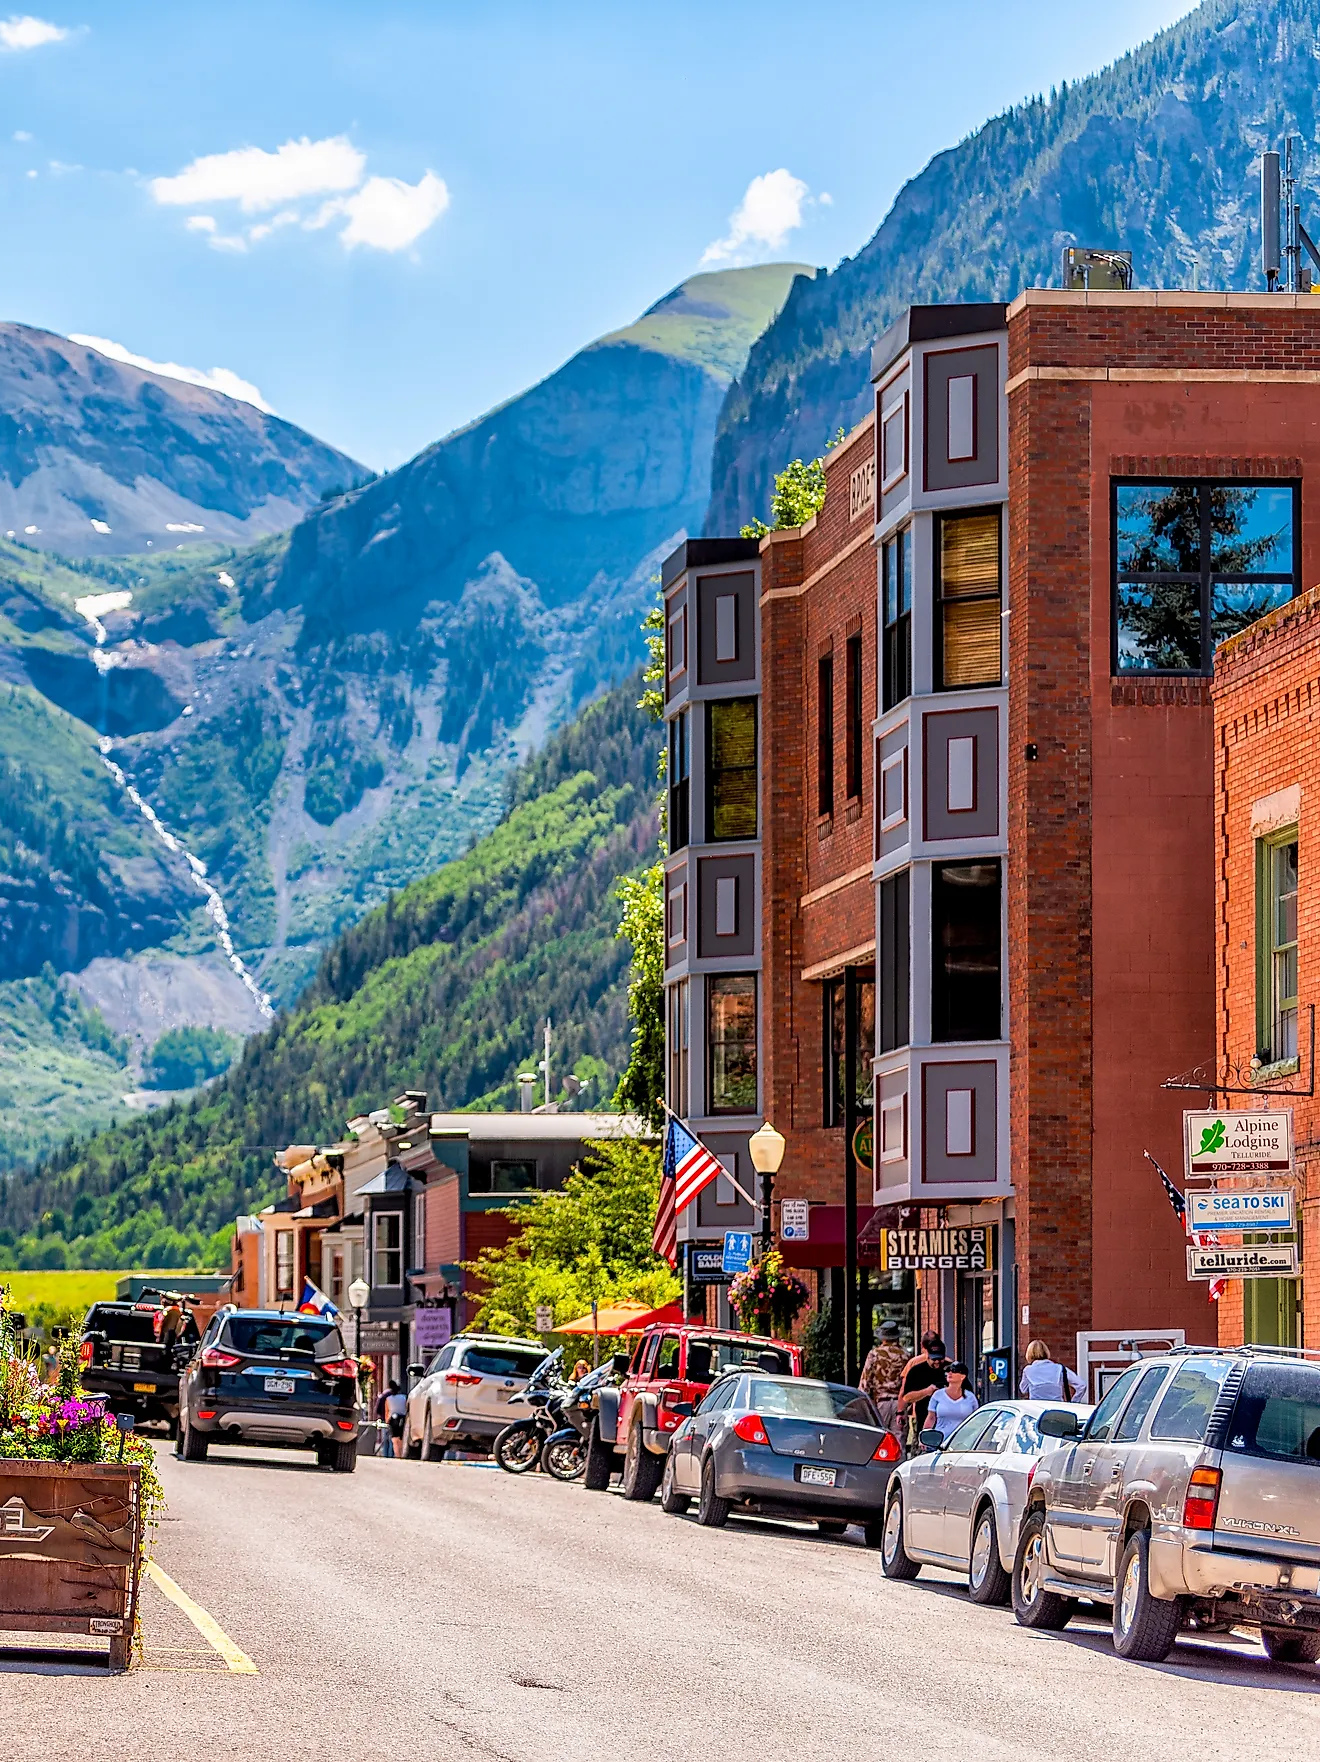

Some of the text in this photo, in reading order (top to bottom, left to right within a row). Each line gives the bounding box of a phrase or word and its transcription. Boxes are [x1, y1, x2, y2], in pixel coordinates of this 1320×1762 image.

[1234, 1118, 1279, 1135] Alpine
[1224, 1134, 1280, 1150] Lodging
[1230, 1151, 1272, 1159] TELLURIDE
[1212, 1162, 1269, 1171] 970-728-3388
[1212, 1196, 1285, 1210] sea TO SKI
[888, 1229, 968, 1256] STEAMIES
[888, 1255, 985, 1270] BURGER
[1200, 1252, 1287, 1267] telluride.com
[1221, 1517, 1301, 1536] YUKON XL
